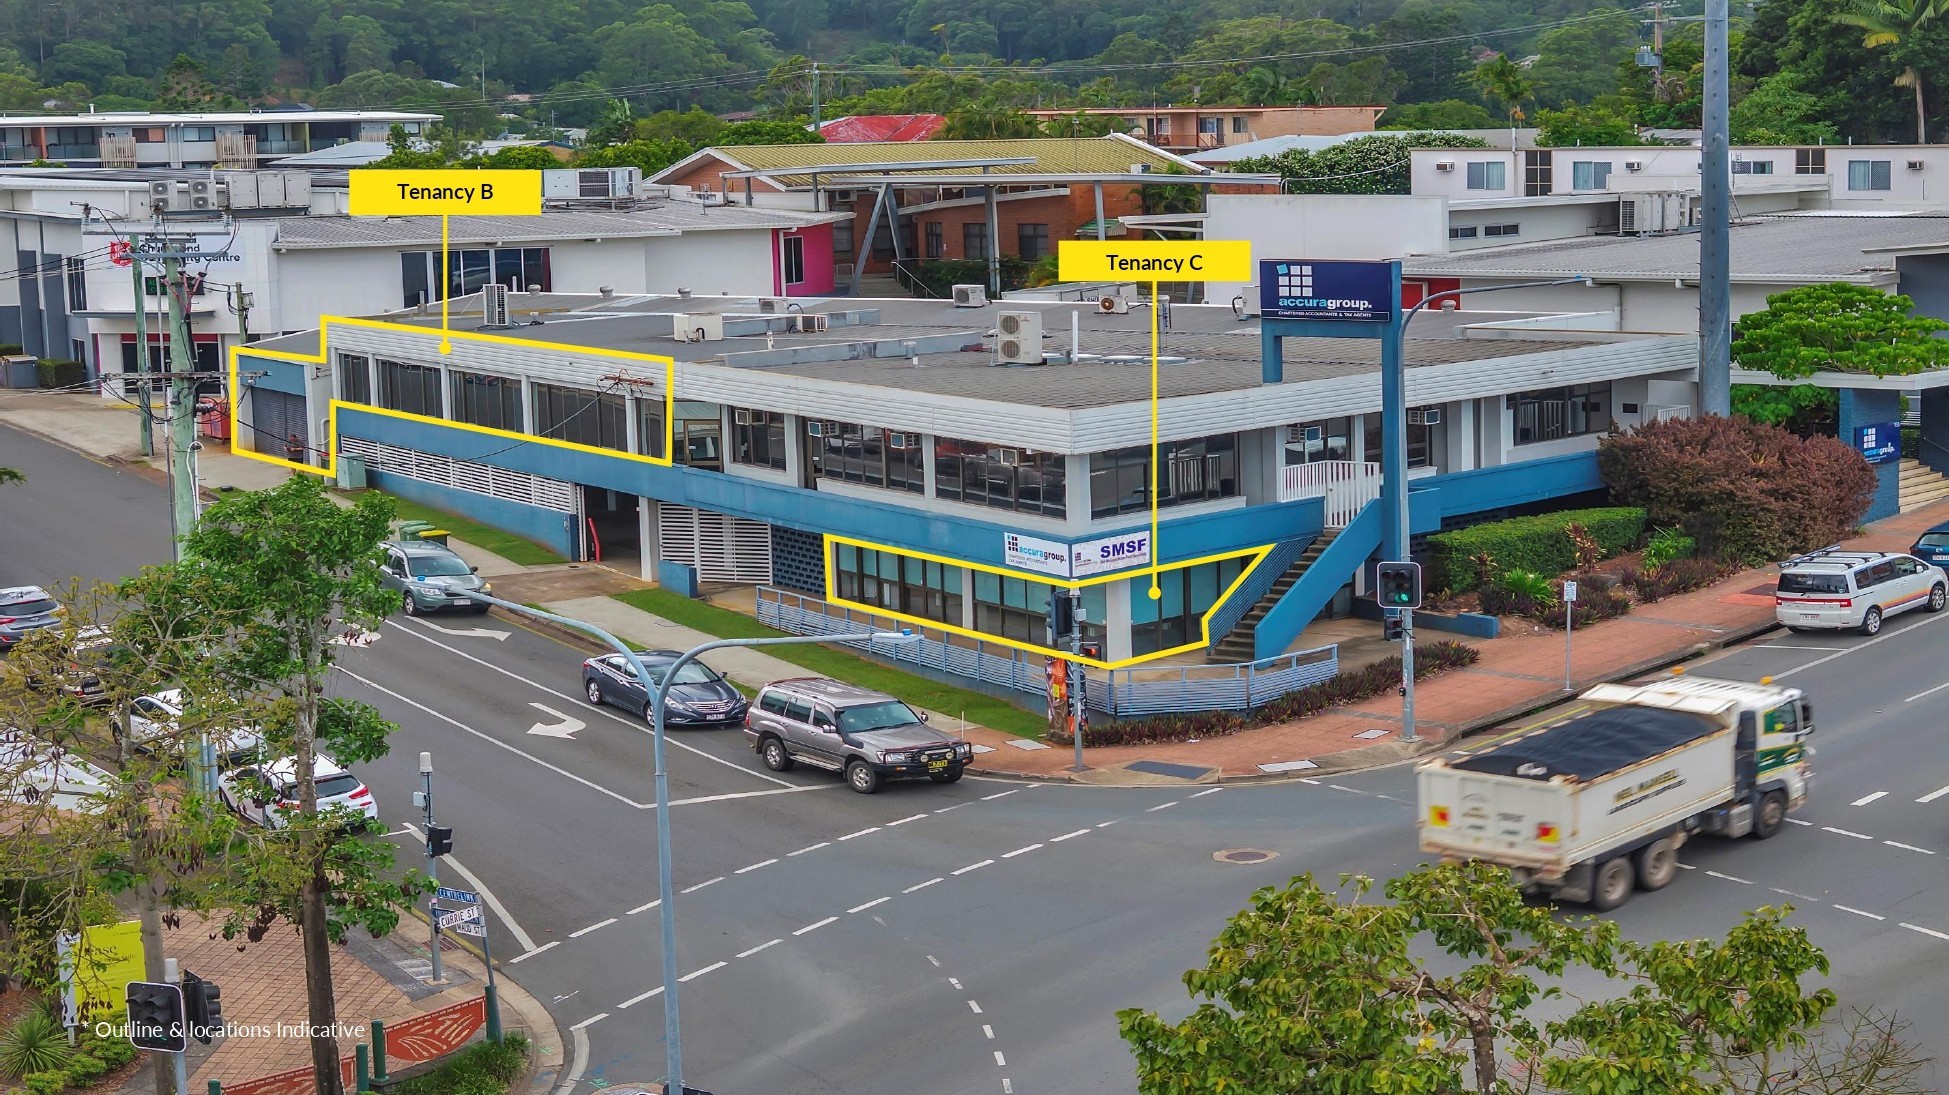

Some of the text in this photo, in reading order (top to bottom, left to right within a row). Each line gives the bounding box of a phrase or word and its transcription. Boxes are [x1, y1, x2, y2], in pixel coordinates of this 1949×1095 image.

[1278, 297, 1373, 311] accuragroup.
[1100, 538, 1147, 558] SMSF
[439, 888, 475, 903] CENTRELINK
[441, 911, 465, 927] CURRIE
[467, 908, 475, 918] ST
[473, 926, 480, 934] ST
